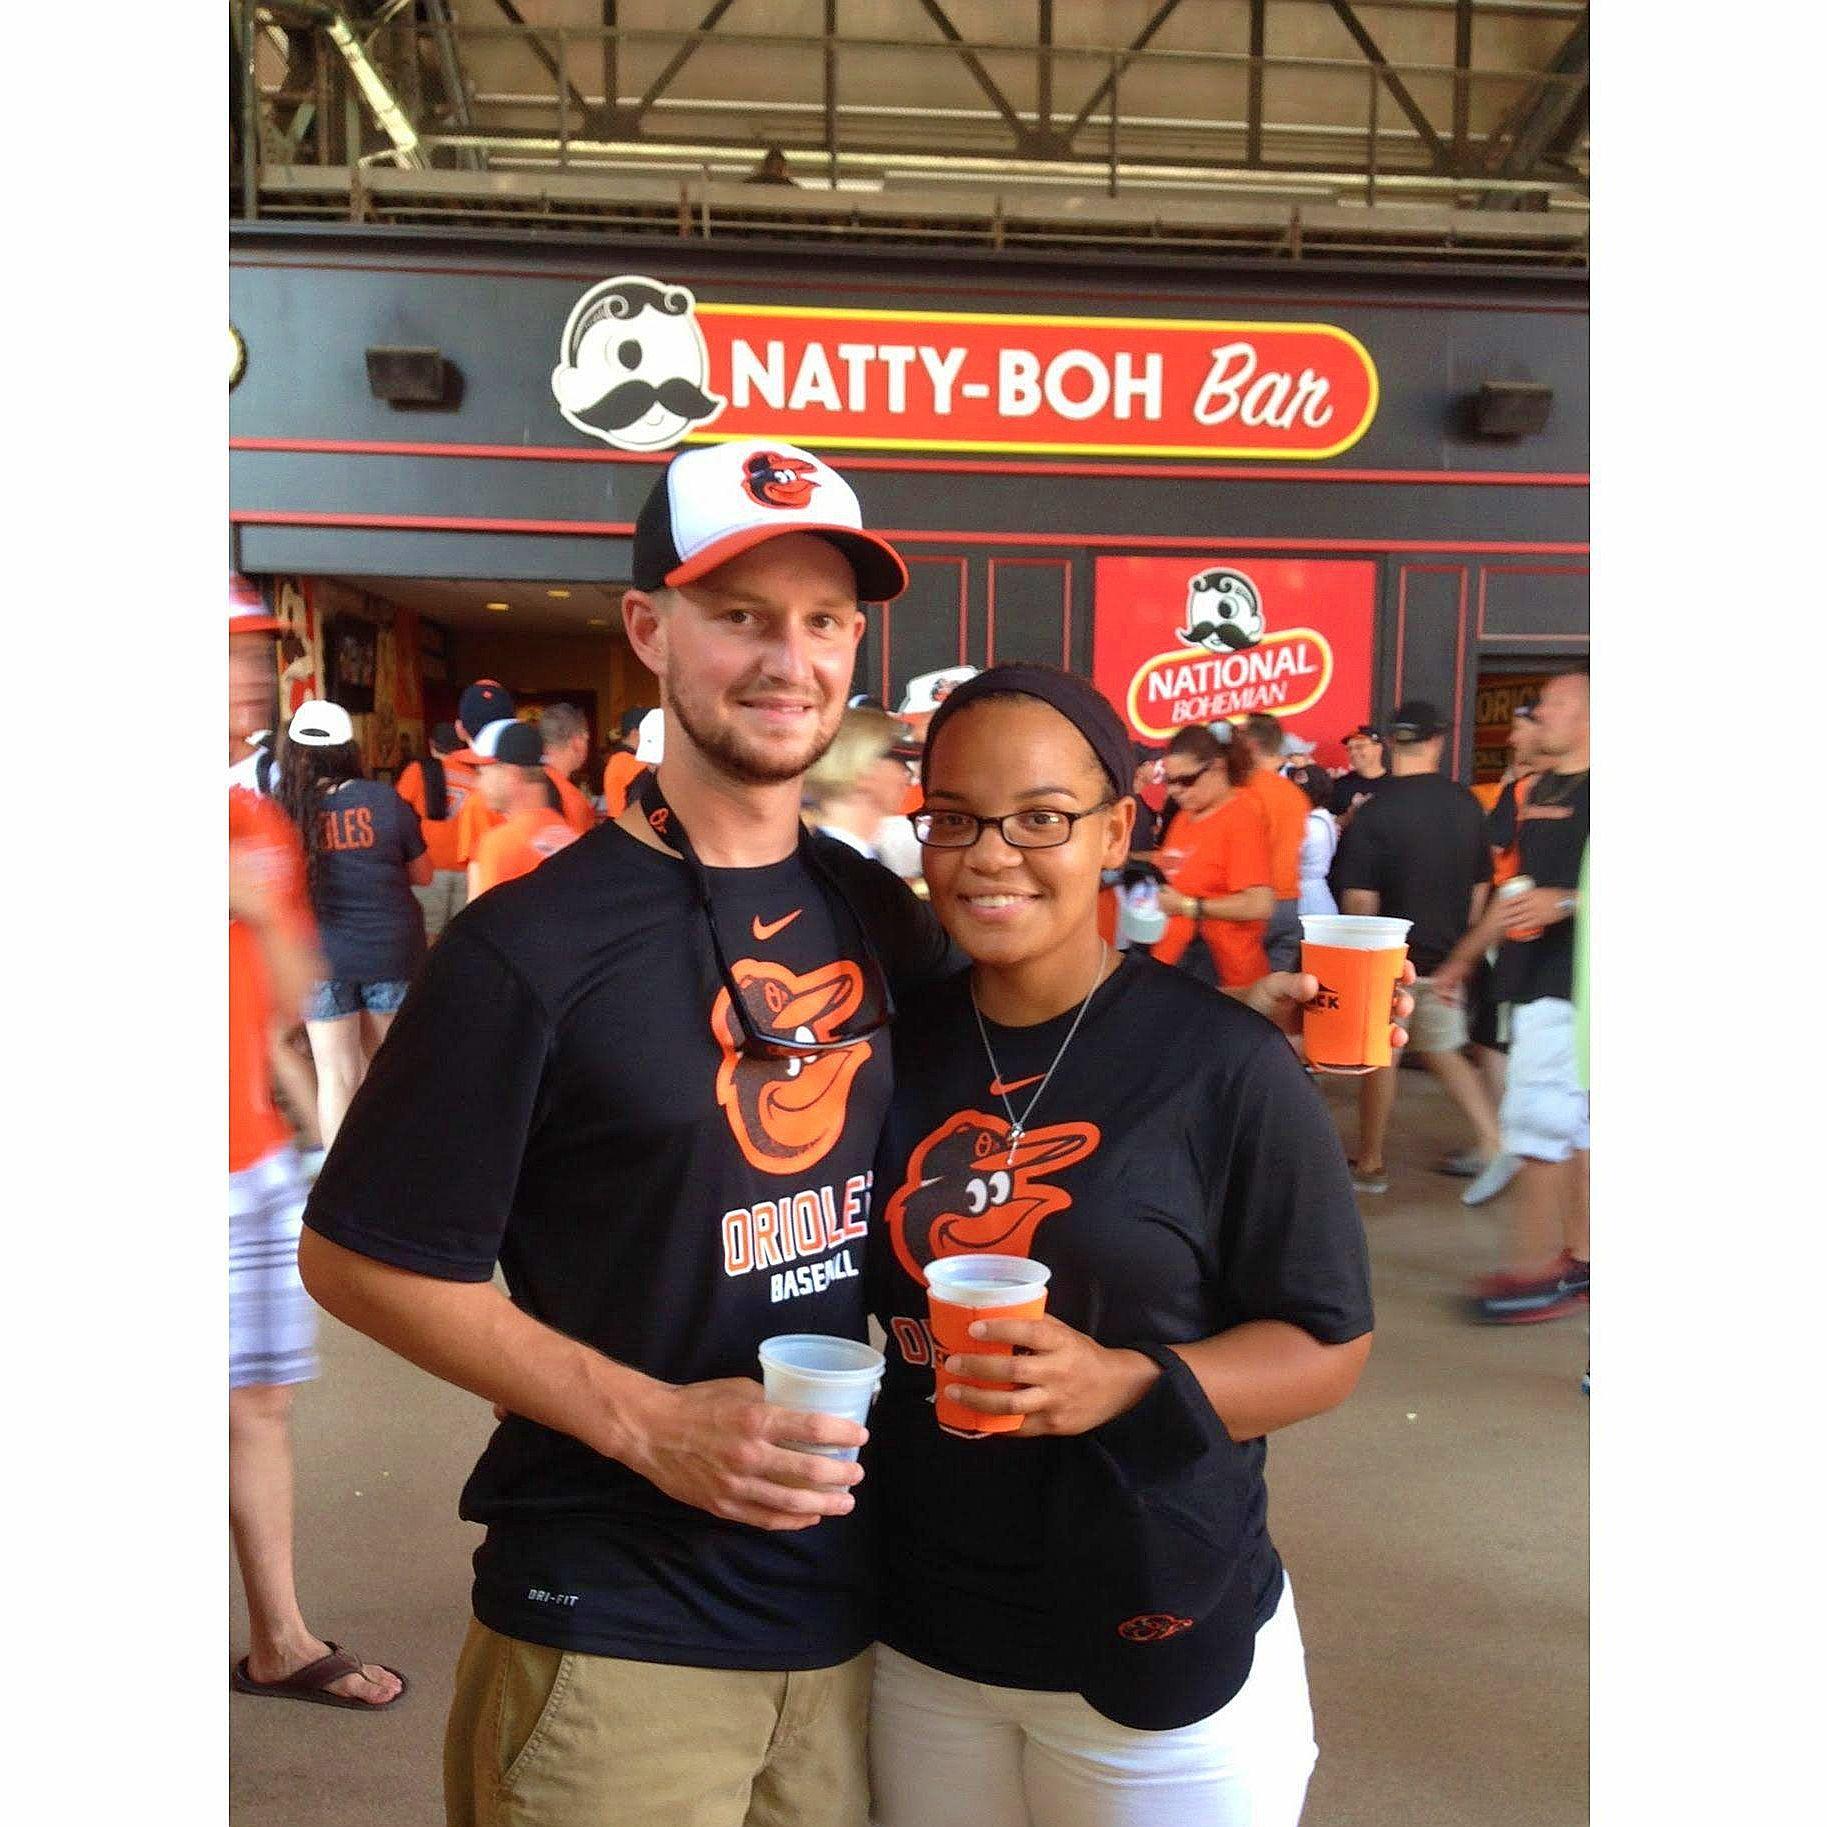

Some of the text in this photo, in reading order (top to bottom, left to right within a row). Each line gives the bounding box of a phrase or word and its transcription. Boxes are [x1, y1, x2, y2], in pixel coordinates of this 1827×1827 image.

[731, 337, 1334, 430] NATTY-BOH Bar
[1147, 643, 1319, 701] NATIONAL
[1171, 680, 1289, 723] BOHEMIAN
